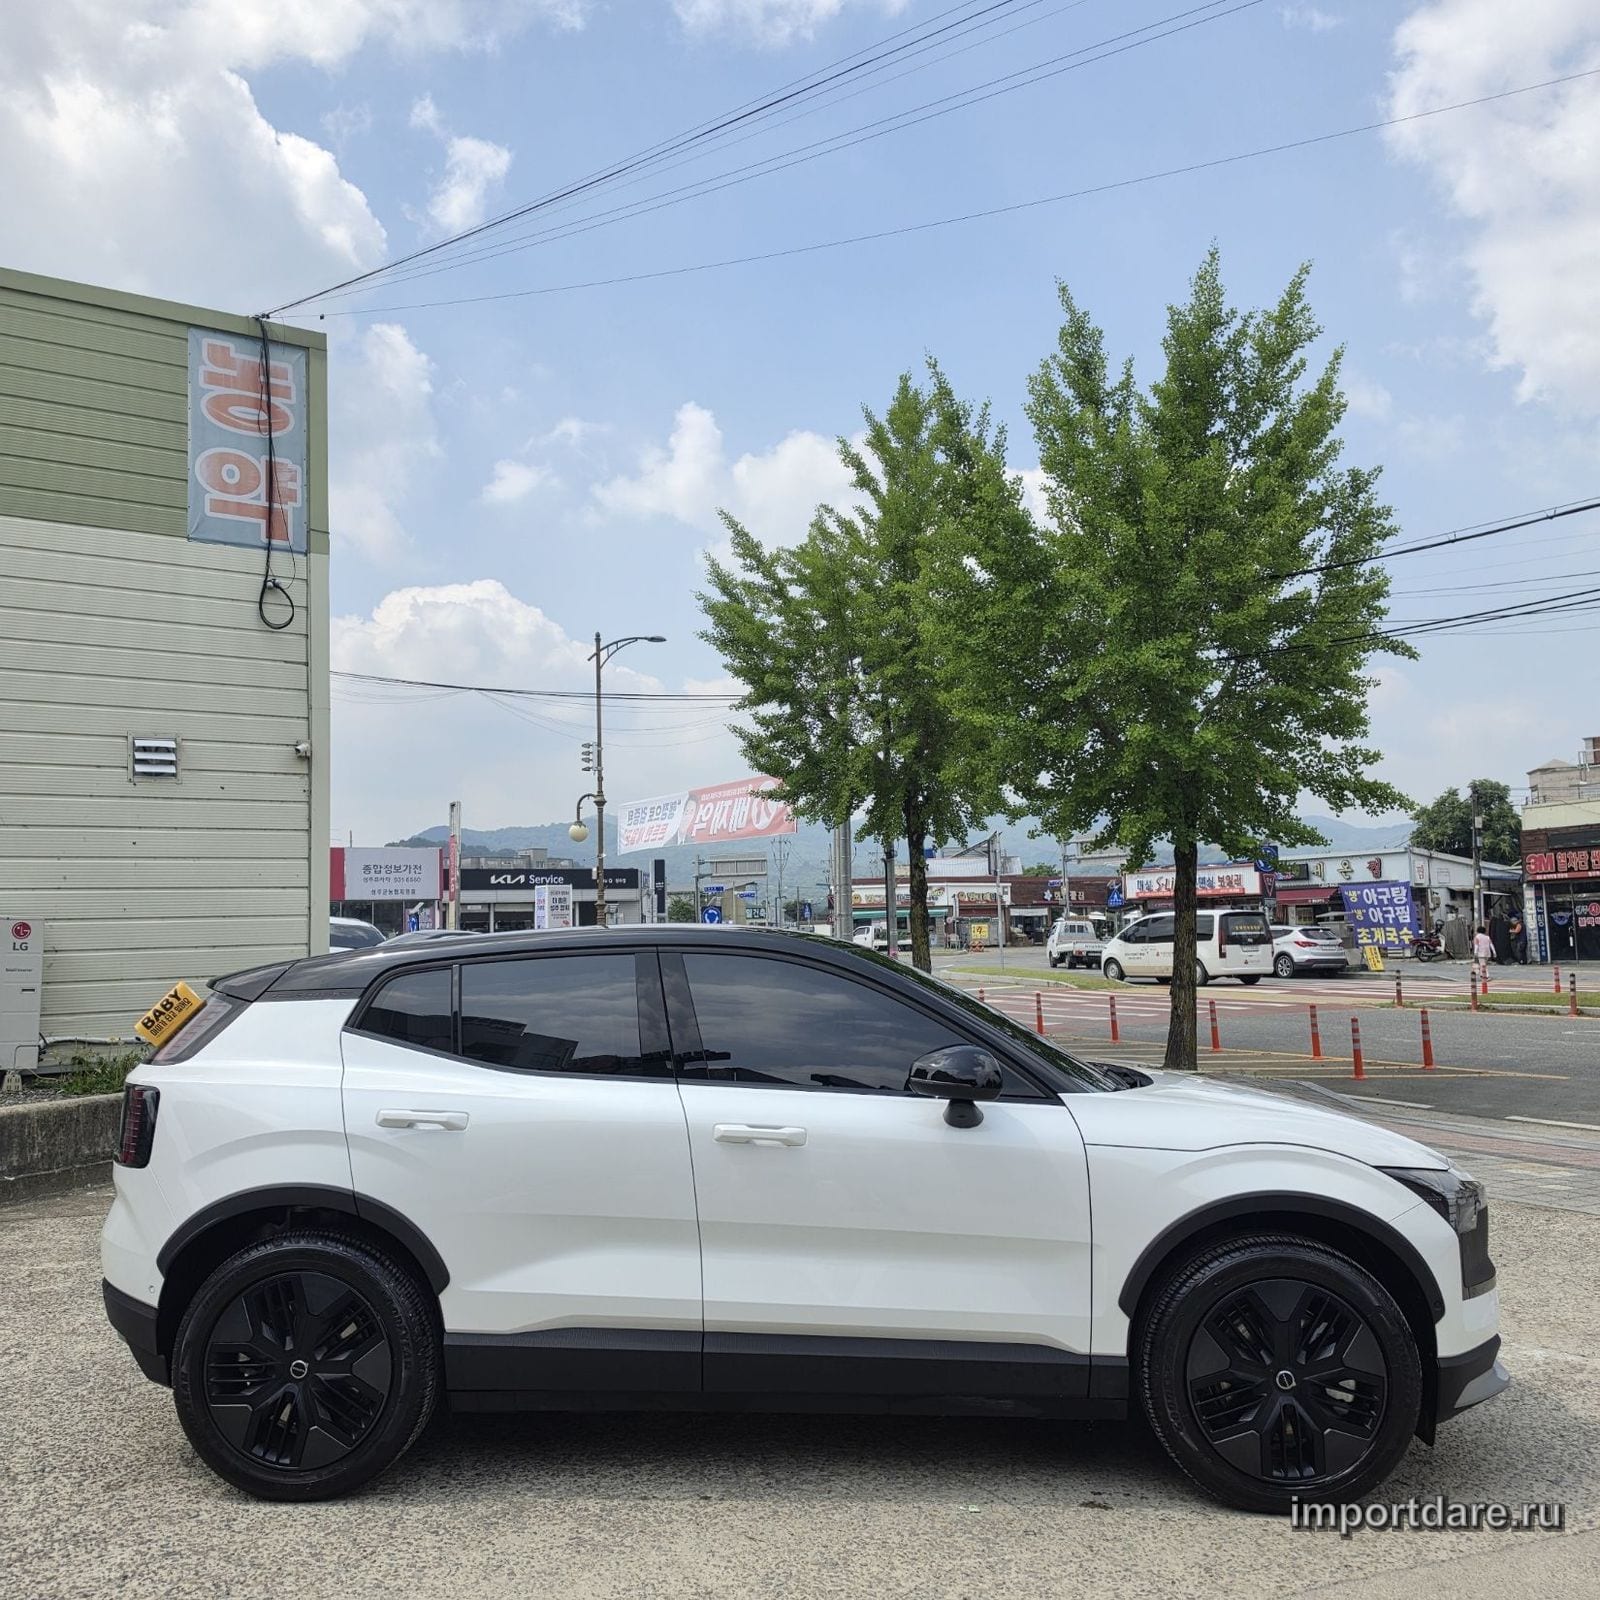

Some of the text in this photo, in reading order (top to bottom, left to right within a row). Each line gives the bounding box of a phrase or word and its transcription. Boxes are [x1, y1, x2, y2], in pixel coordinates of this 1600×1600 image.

[362, 864, 423, 875] 종합정보가전
[1525, 852, 1556, 875] 3M
[1555, 850, 1589, 873] 열차단
[490, 874, 565, 885] KIA Service
[1363, 885, 1408, 905] 아구탕
[1368, 905, 1411, 924] 아구찜
[12, 942, 29, 952] LG
[141, 988, 182, 1031] BABY
